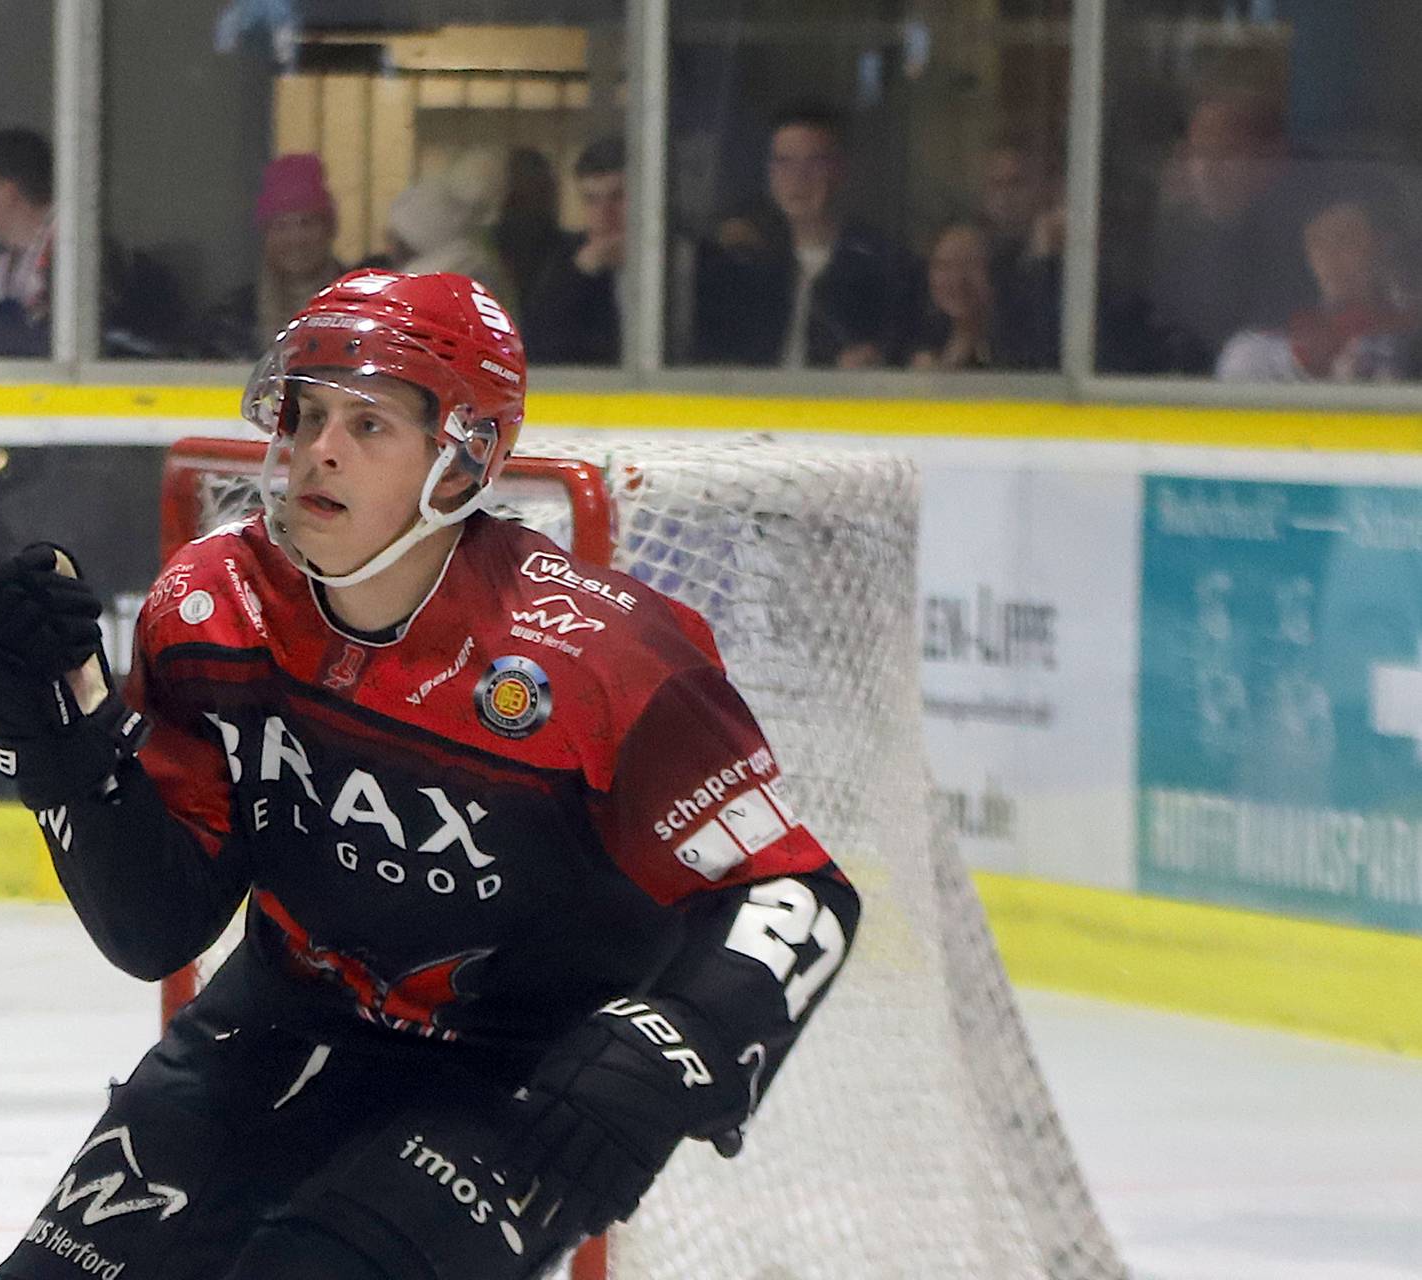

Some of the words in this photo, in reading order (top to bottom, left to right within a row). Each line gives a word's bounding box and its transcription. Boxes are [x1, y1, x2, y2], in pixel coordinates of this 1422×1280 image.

[539, 557, 638, 612] WESLE
[202, 711, 497, 869] BRAX
[653, 757, 749, 842] schaper
[336, 841, 503, 900] GOOD
[724, 876, 848, 1024] 27
[398, 1134, 494, 1225] imos
[45, 1225, 126, 1280] Herford
